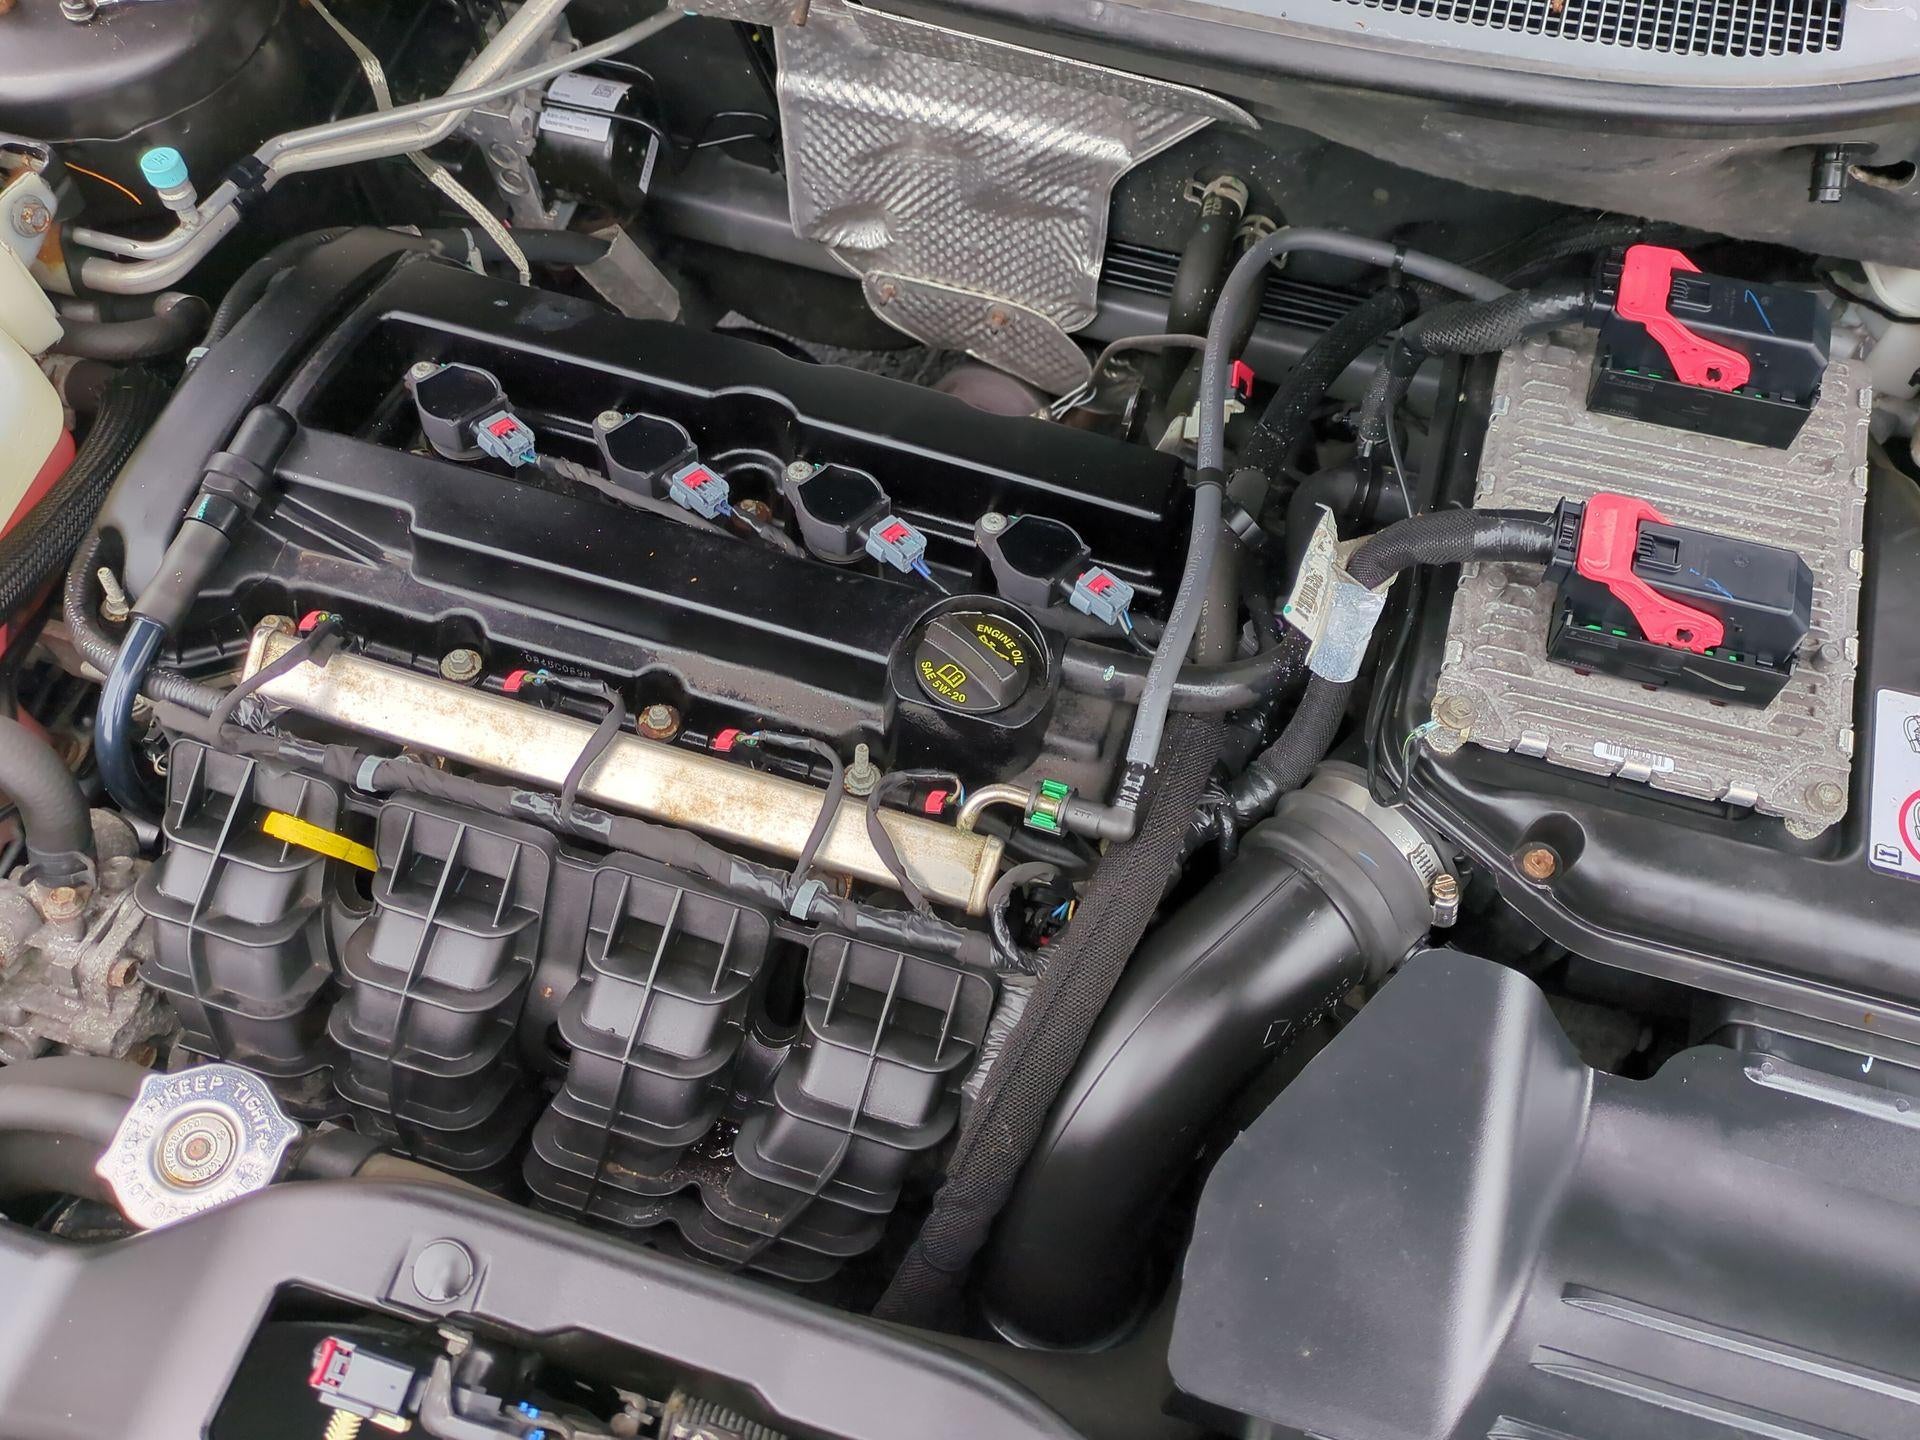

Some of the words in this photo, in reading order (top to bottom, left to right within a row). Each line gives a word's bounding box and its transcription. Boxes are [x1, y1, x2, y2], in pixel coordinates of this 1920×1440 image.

[976, 624, 1016, 650] ENGINE
[1011, 649, 1024, 666] OIL
[921, 660, 937, 681] SAE
[932, 680, 967, 704] 5W-20
[164, 1074, 225, 1100] KEEP
[232, 1081, 273, 1133] TIGHT
